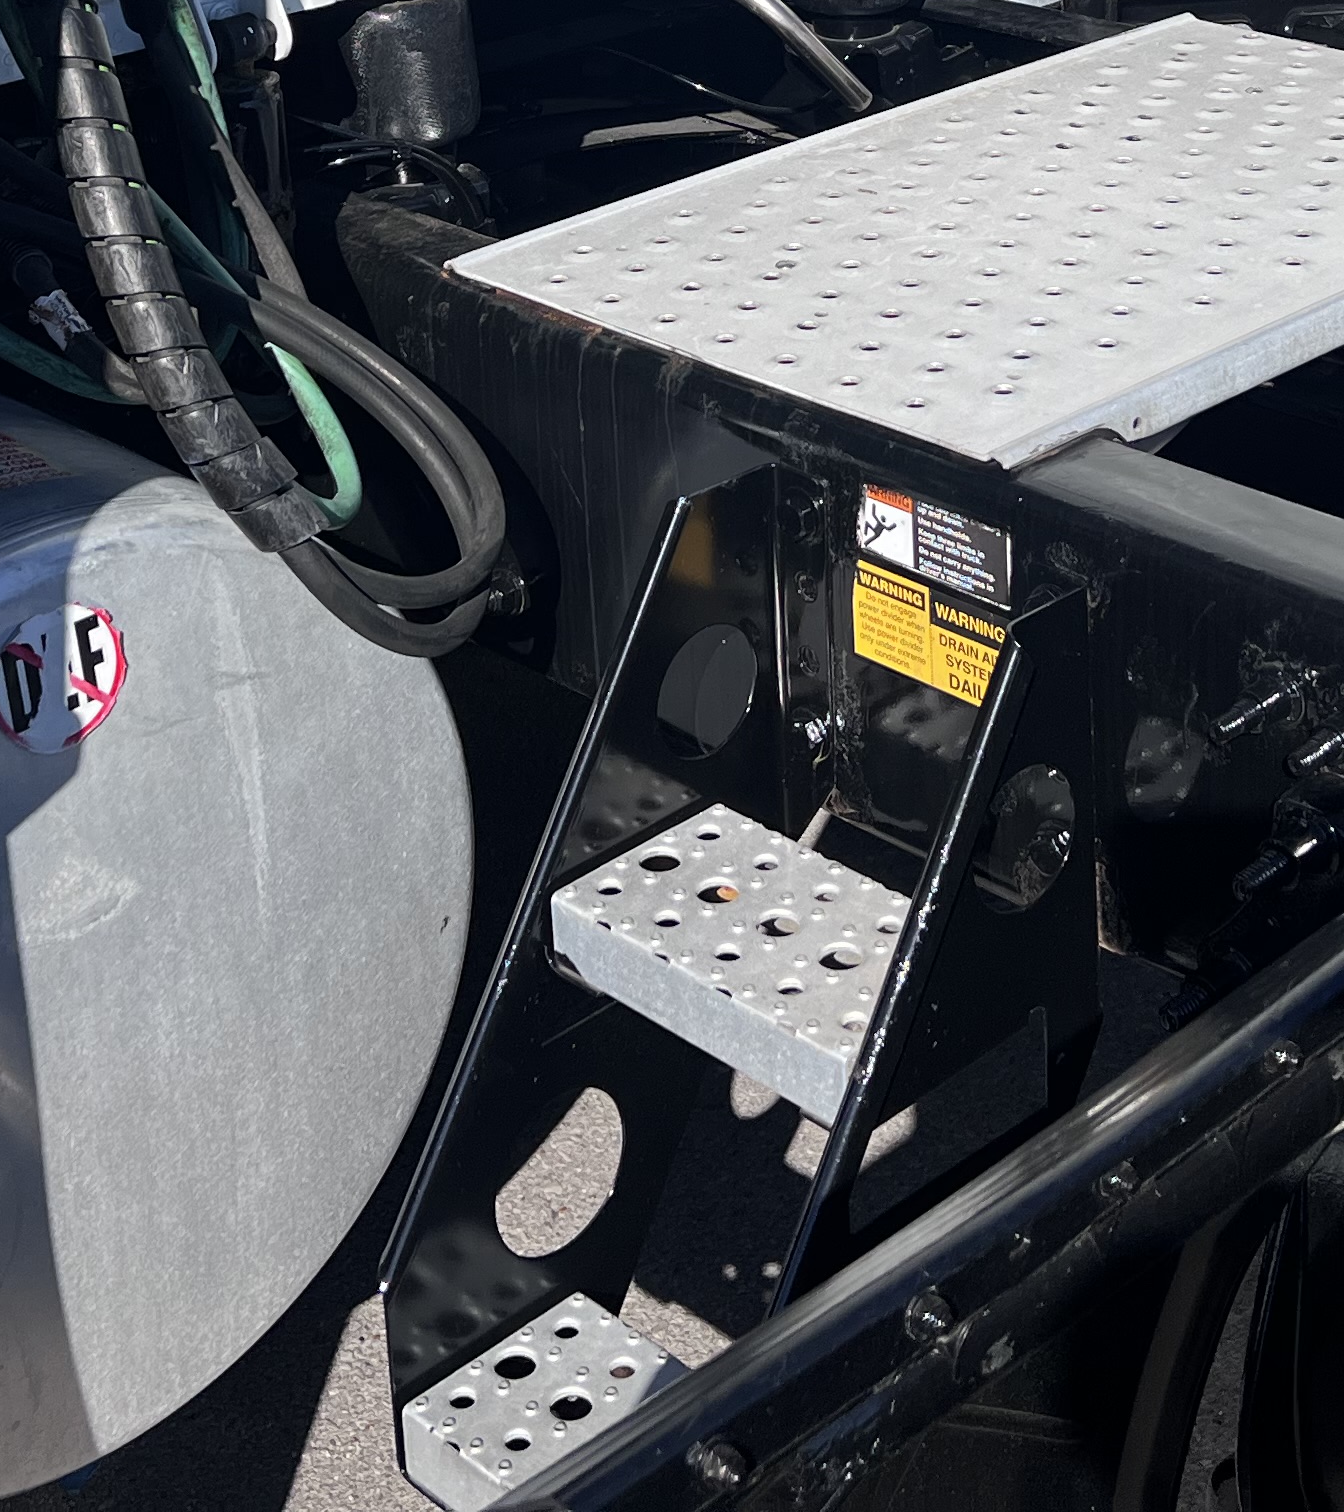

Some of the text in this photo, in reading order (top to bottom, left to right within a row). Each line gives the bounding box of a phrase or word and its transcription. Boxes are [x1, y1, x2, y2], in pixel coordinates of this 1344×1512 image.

[918, 516, 931, 528] Use
[918, 527, 936, 541] Keep
[977, 550, 985, 559] in
[945, 546, 960, 557] with
[919, 546, 929, 556] Do
[930, 552, 942, 561] not
[943, 556, 961, 569] carry
[859, 570, 923, 607] WARNING
[986, 583, 994, 593] in
[859, 601, 879, 613] power
[906, 620, 925, 633] when
[866, 591, 916, 619] Do not engage
[859, 611, 883, 626] wheels
[886, 622, 897, 632] are
[862, 621, 875, 633] Use
[877, 629, 898, 643] power
[935, 601, 1006, 643] WARNING
[860, 632, 874, 645] only
[876, 640, 896, 651] under
[939, 633, 997, 666] DRAIN AI
[1, 614, 104, 733] DF
[946, 653, 992, 681] SYSTE
